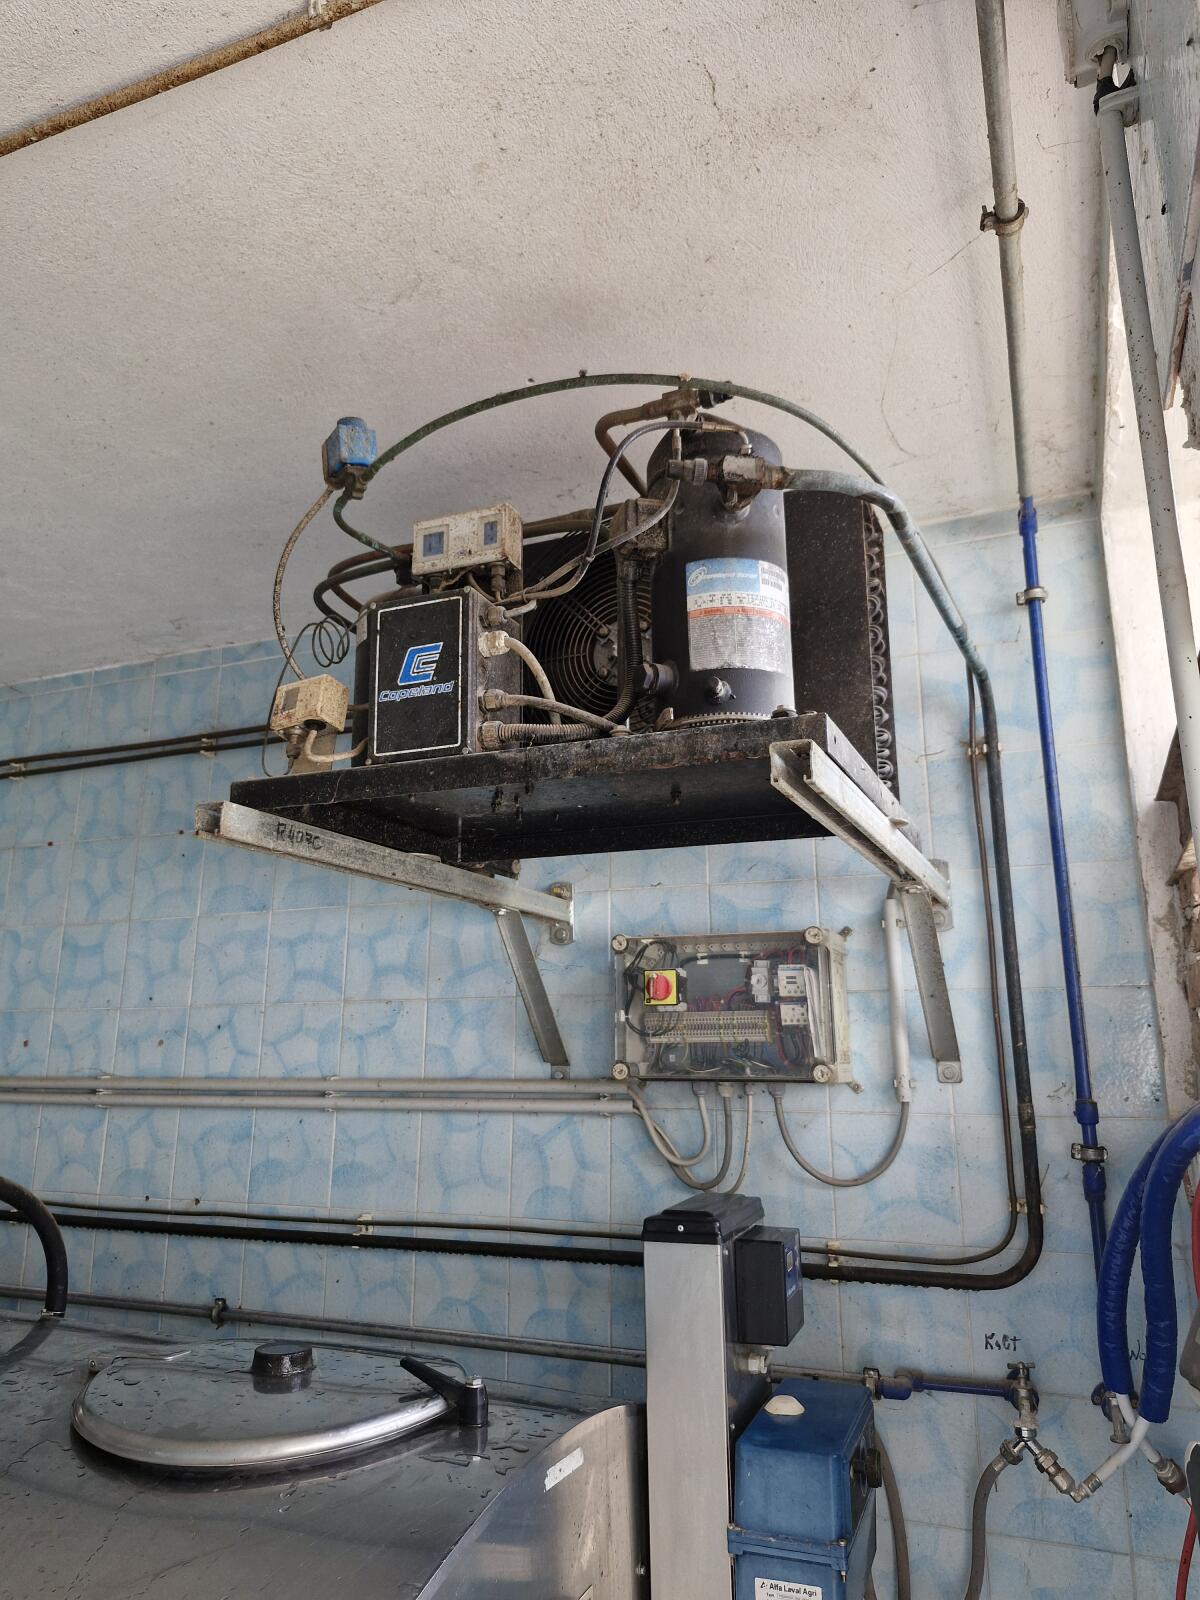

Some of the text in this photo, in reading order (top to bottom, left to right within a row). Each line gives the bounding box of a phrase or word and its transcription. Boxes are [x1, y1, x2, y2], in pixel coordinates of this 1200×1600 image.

[378, 680, 455, 703] Copeland
[769, 1582, 783, 1591] Alfa
[783, 1585, 801, 1594] Laval
[802, 1588, 817, 1597] Agri
